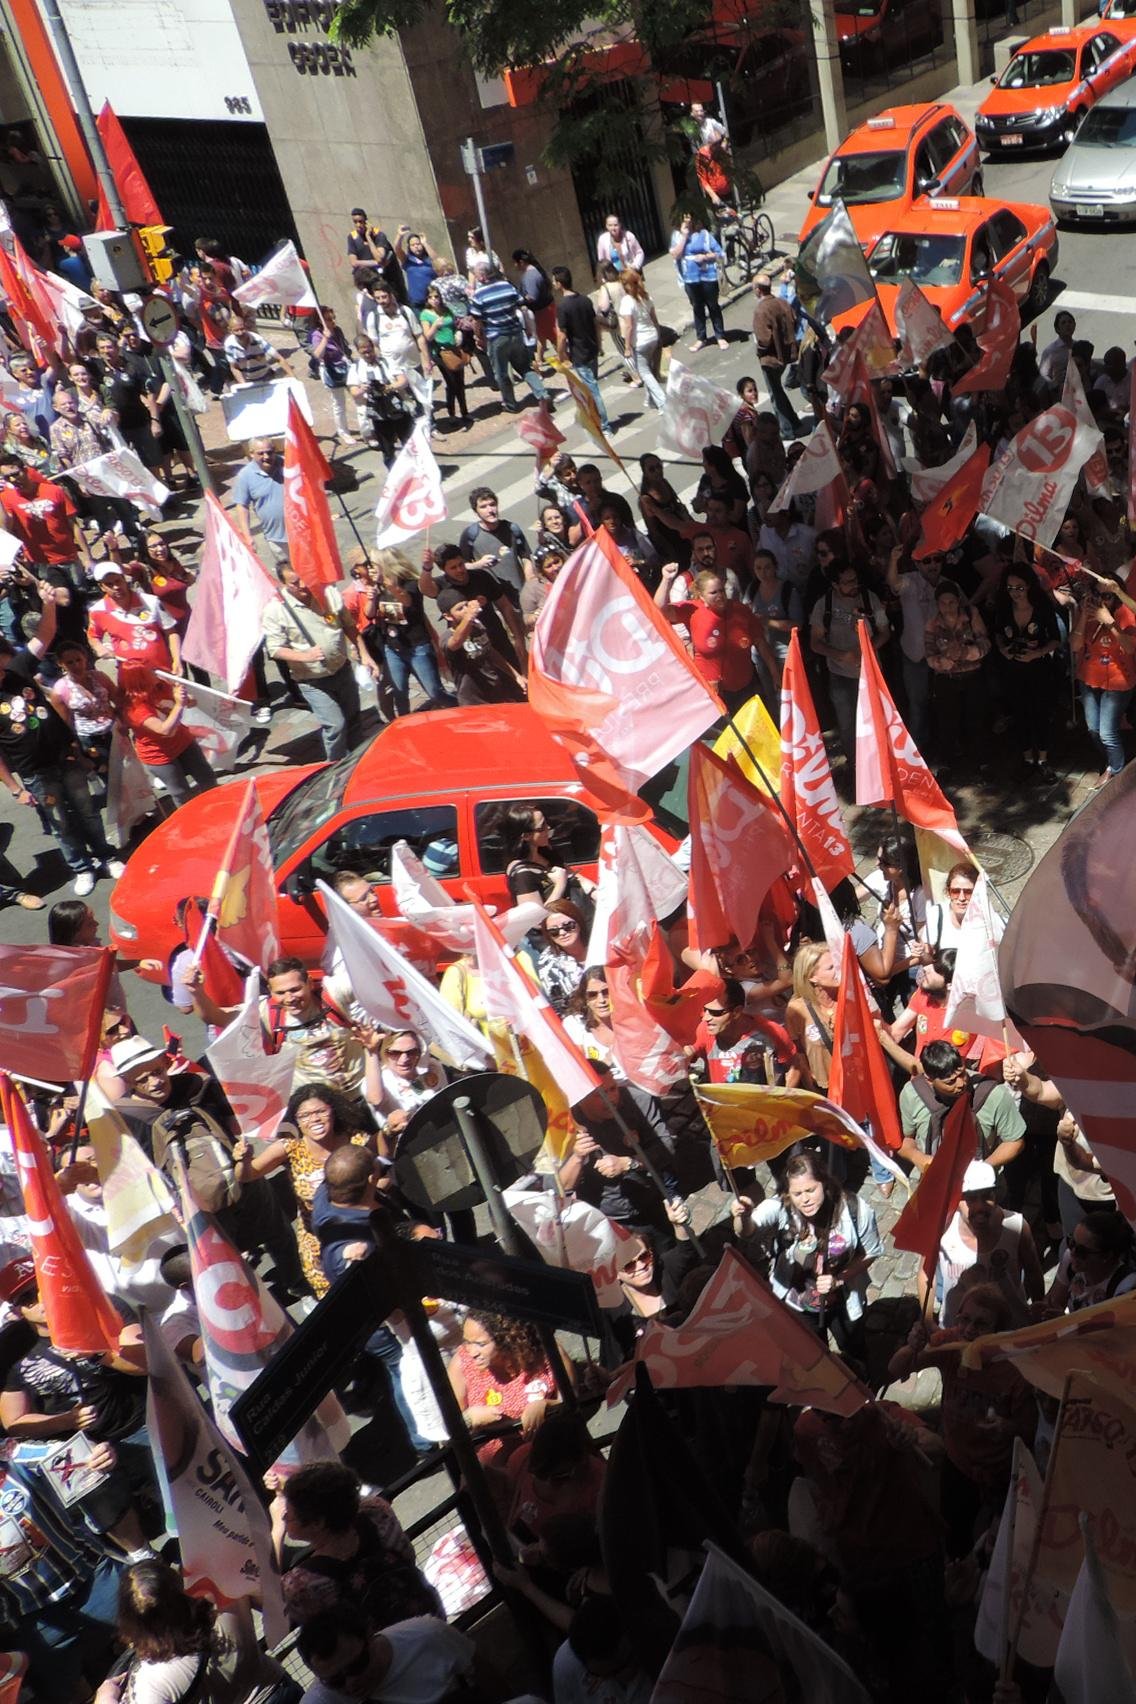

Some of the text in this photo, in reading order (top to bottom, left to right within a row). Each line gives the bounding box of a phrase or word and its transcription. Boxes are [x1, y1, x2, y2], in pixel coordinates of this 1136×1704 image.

[1020, 413, 1073, 466] 13
[1015, 480, 1058, 541] Dilma
[823, 835, 846, 856] 13
[253, 1386, 294, 1435] Caldas
